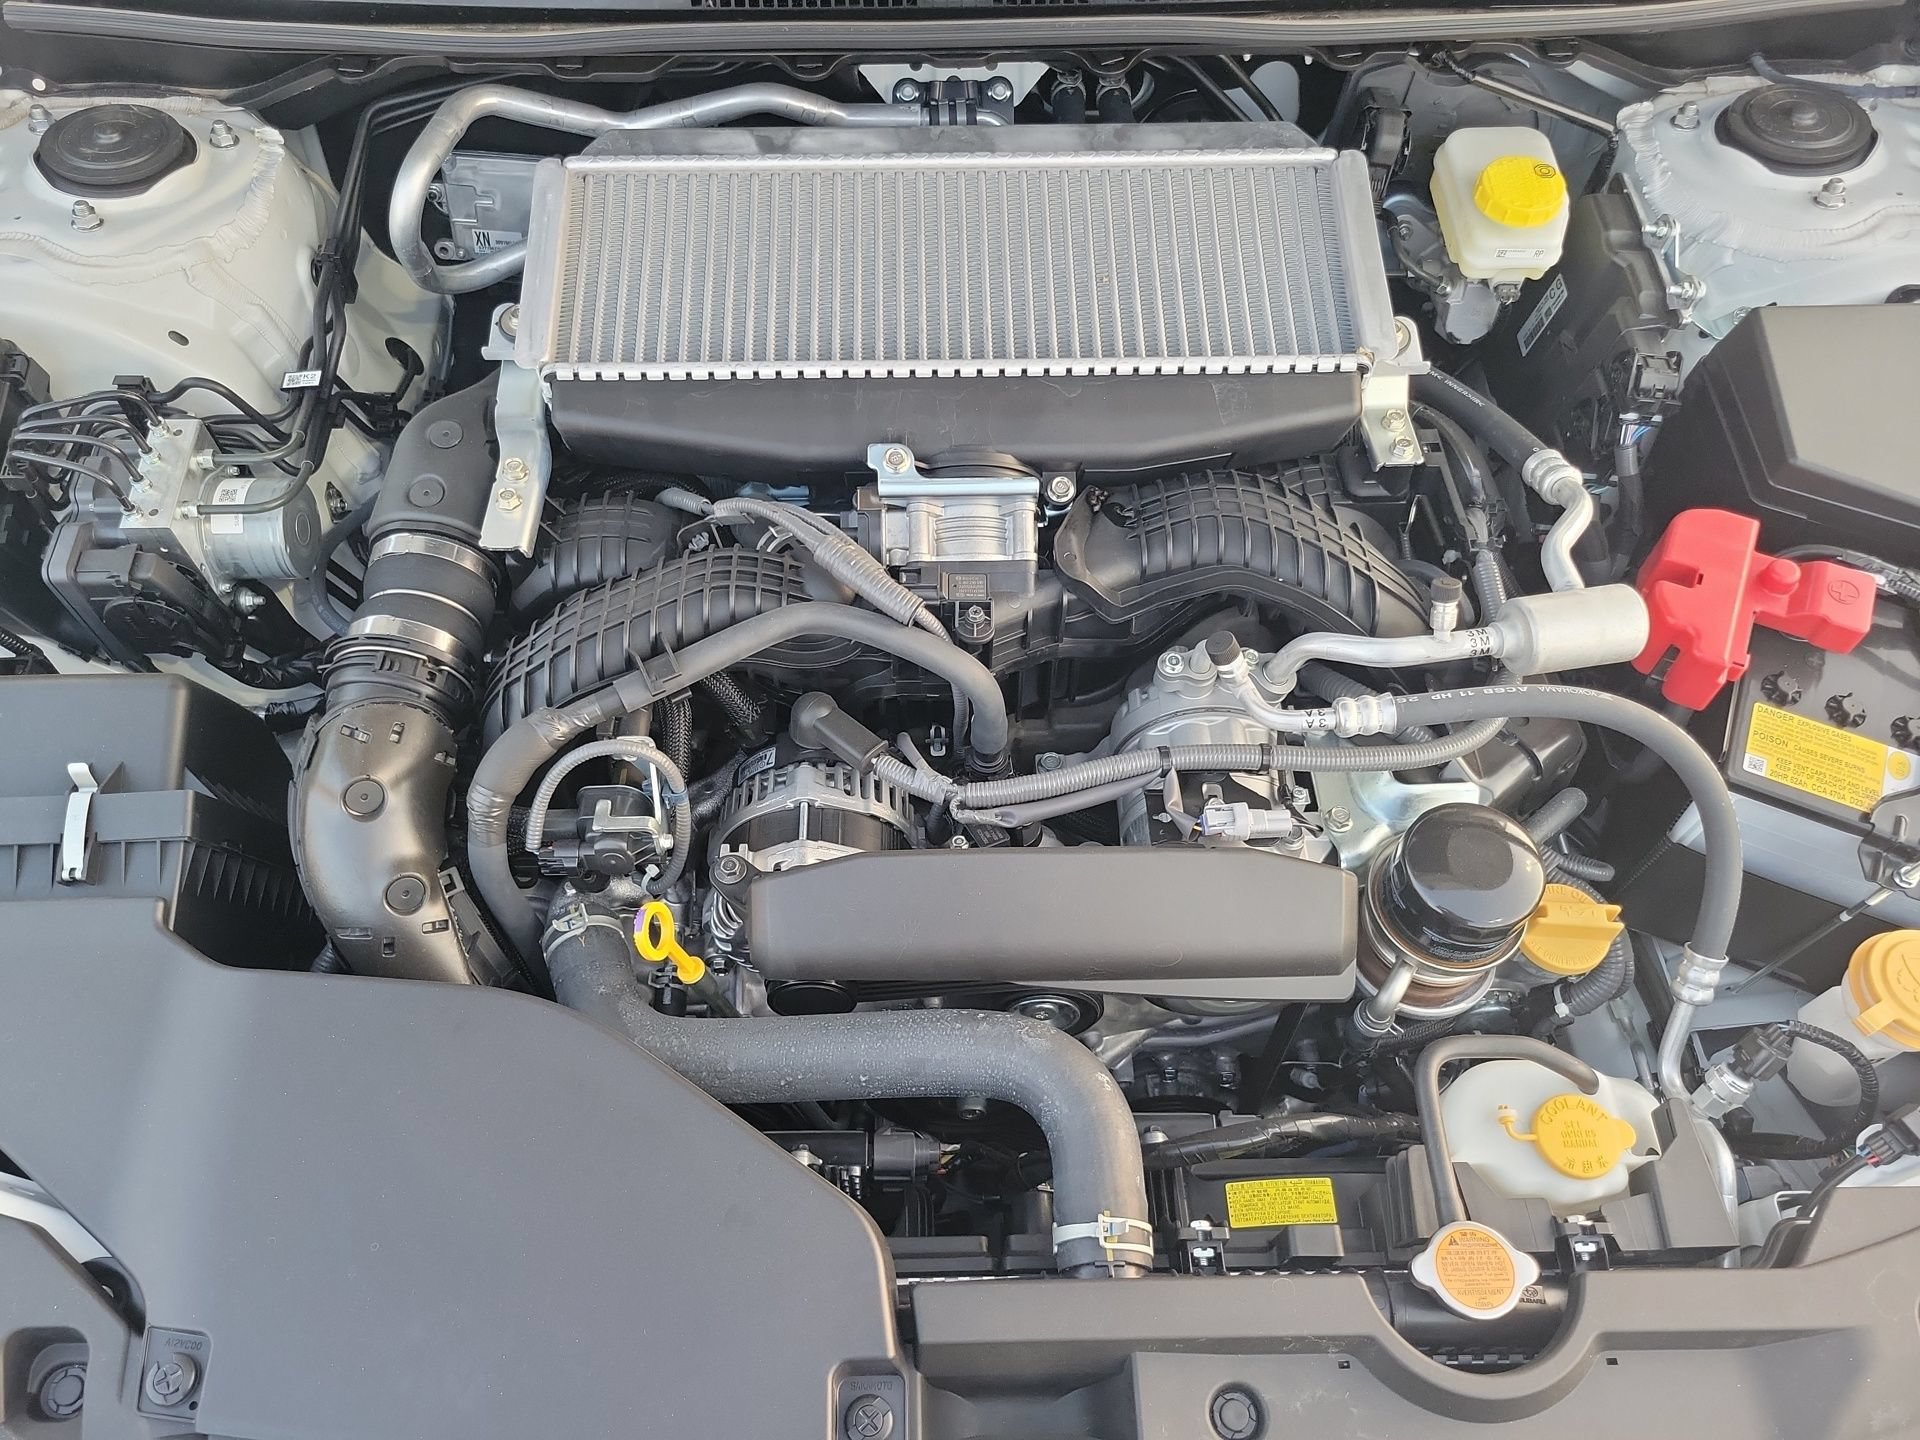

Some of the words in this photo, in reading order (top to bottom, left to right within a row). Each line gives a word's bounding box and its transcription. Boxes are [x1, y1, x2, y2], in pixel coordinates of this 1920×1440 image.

[474, 231, 491, 247] XN
[1431, 692, 1452, 700] HP
[1537, 686, 1598, 697] YOKOHAMA
[1757, 705, 1794, 723] DANGER
[1797, 719, 1831, 735] EXPLOSIVE
[1830, 730, 1852, 742] GASES
[1752, 730, 1789, 748] POISON
[1793, 745, 1819, 758] CAUSES
[1819, 753, 1843, 766] SEVERE
[1844, 762, 1865, 773] BURNS
[1775, 763, 1792, 773] KEEP
[1793, 769, 1805, 778] OUT
[1816, 777, 1837, 789] REACH
[1776, 757, 1792, 767] KEEP
[1793, 763, 1809, 772] VENT
[1810, 768, 1827, 778] CAPS
[1828, 774, 1846, 785] TIGHT
[1846, 781, 1861, 790] AND
[1811, 784, 1828, 794] CCA
[1540, 1098, 1608, 1125] COOLANT
